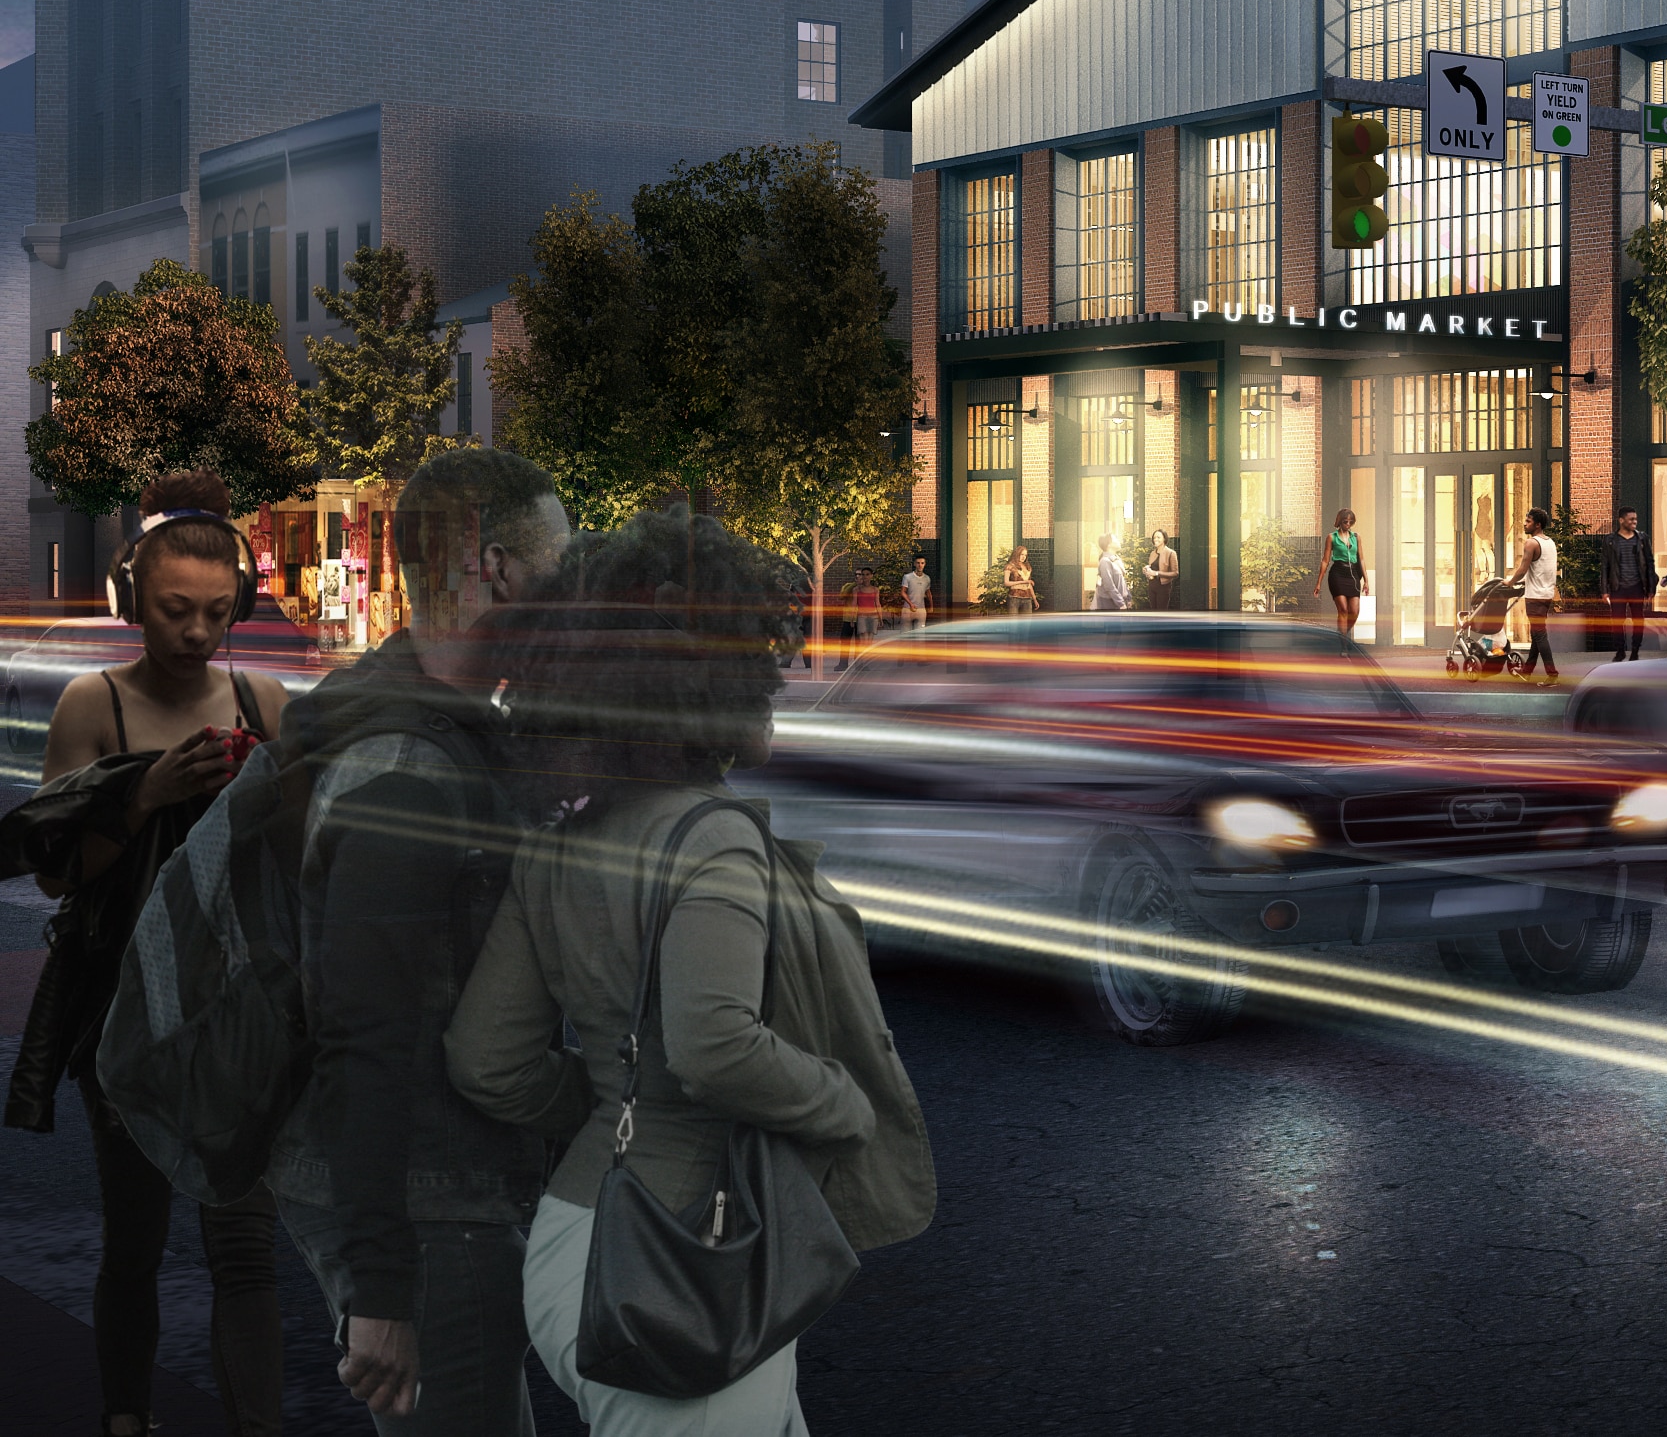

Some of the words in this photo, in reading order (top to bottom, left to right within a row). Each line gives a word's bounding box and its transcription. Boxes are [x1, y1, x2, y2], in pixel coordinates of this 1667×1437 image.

[1541, 79, 1559, 92] LEFT
[1562, 82, 1584, 94] TURN
[1547, 94, 1577, 109] YIELD
[1542, 109, 1554, 119] ON
[1556, 111, 1582, 123] GREEN
[1439, 127, 1495, 150] ONLY
[1193, 300, 1357, 329] PUBLIC
[1386, 311, 1548, 339] MARKET
